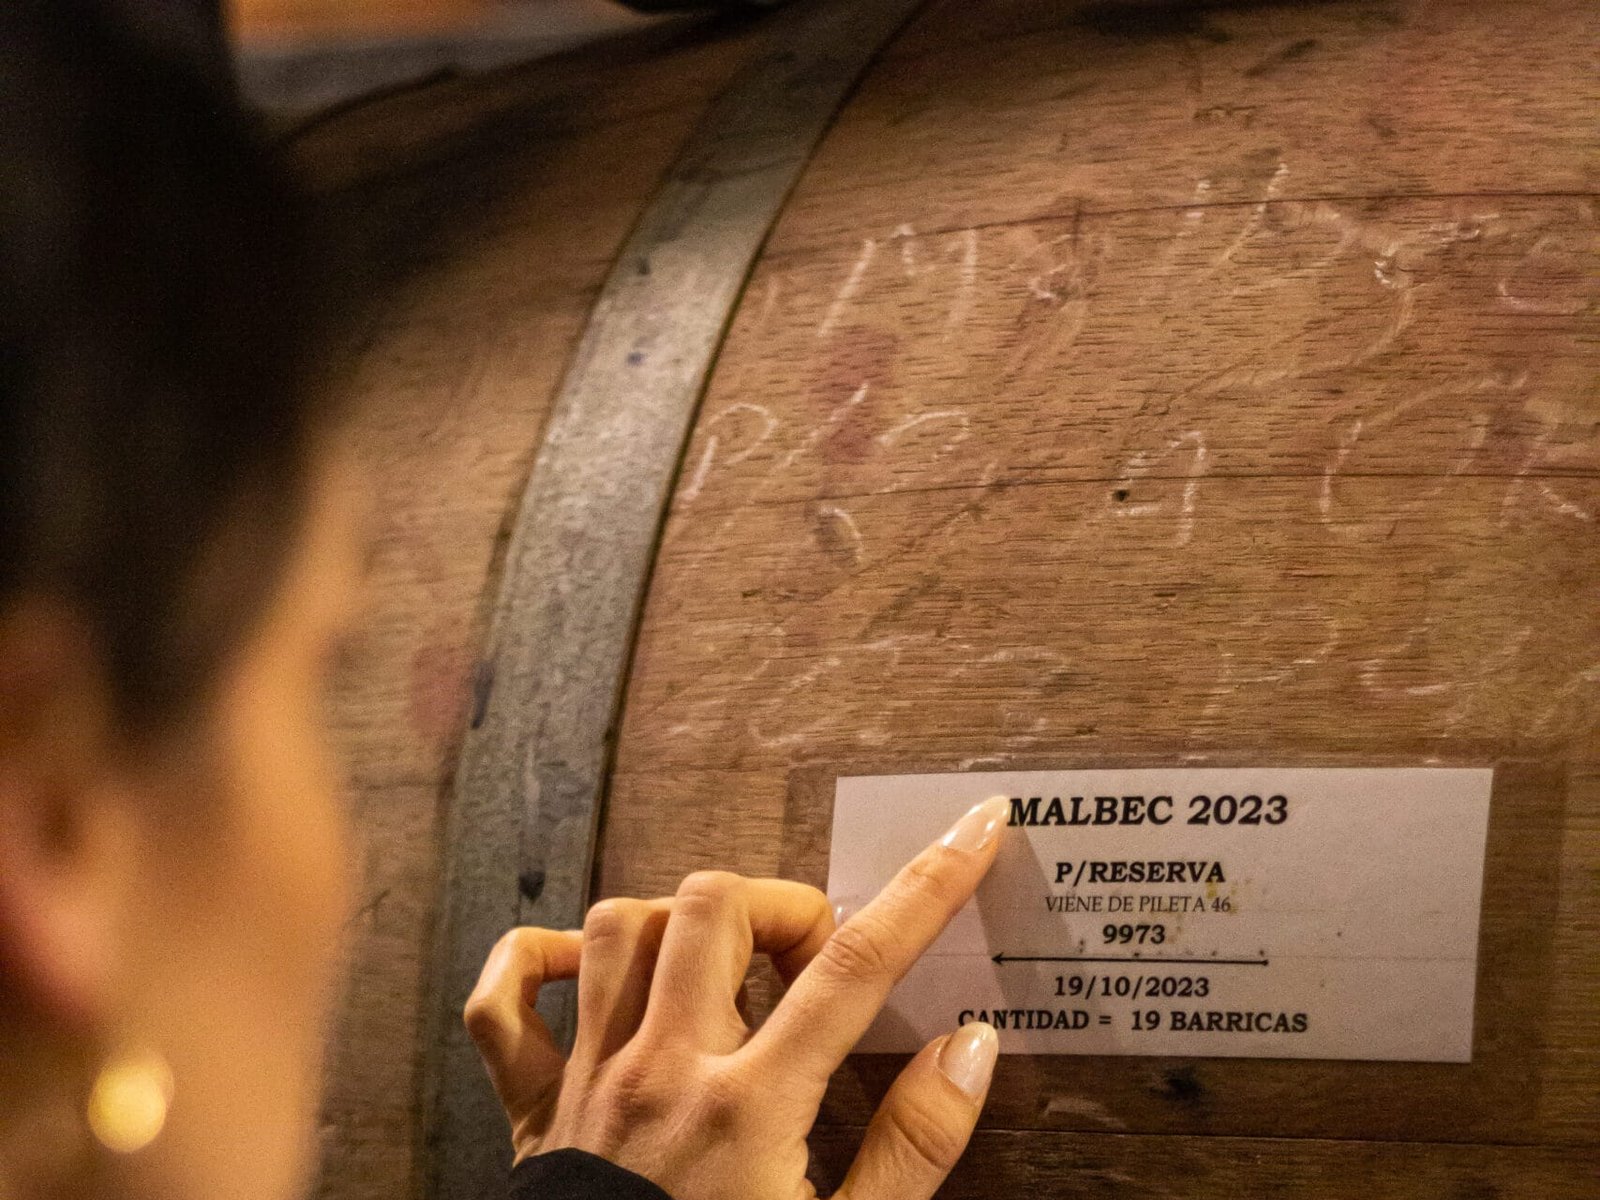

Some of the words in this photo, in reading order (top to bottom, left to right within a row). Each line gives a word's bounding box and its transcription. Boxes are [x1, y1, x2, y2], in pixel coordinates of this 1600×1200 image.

[1009, 797, 1173, 826] MALBEC
[1187, 796, 1288, 825] 2023
[1055, 861, 1226, 886] P/RESERVA
[1045, 896, 1102, 912] VIENE
[1108, 896, 1133, 912] DE
[1140, 896, 1205, 912] PILETA
[1212, 897, 1231, 912] 46
[1103, 924, 1165, 943] 9973
[1055, 976, 1209, 999] 19/10/2023
[958, 1010, 1089, 1029] CANTIDAD
[1132, 1010, 1160, 1030] 19
[1170, 1011, 1307, 1033] BARRICAS
